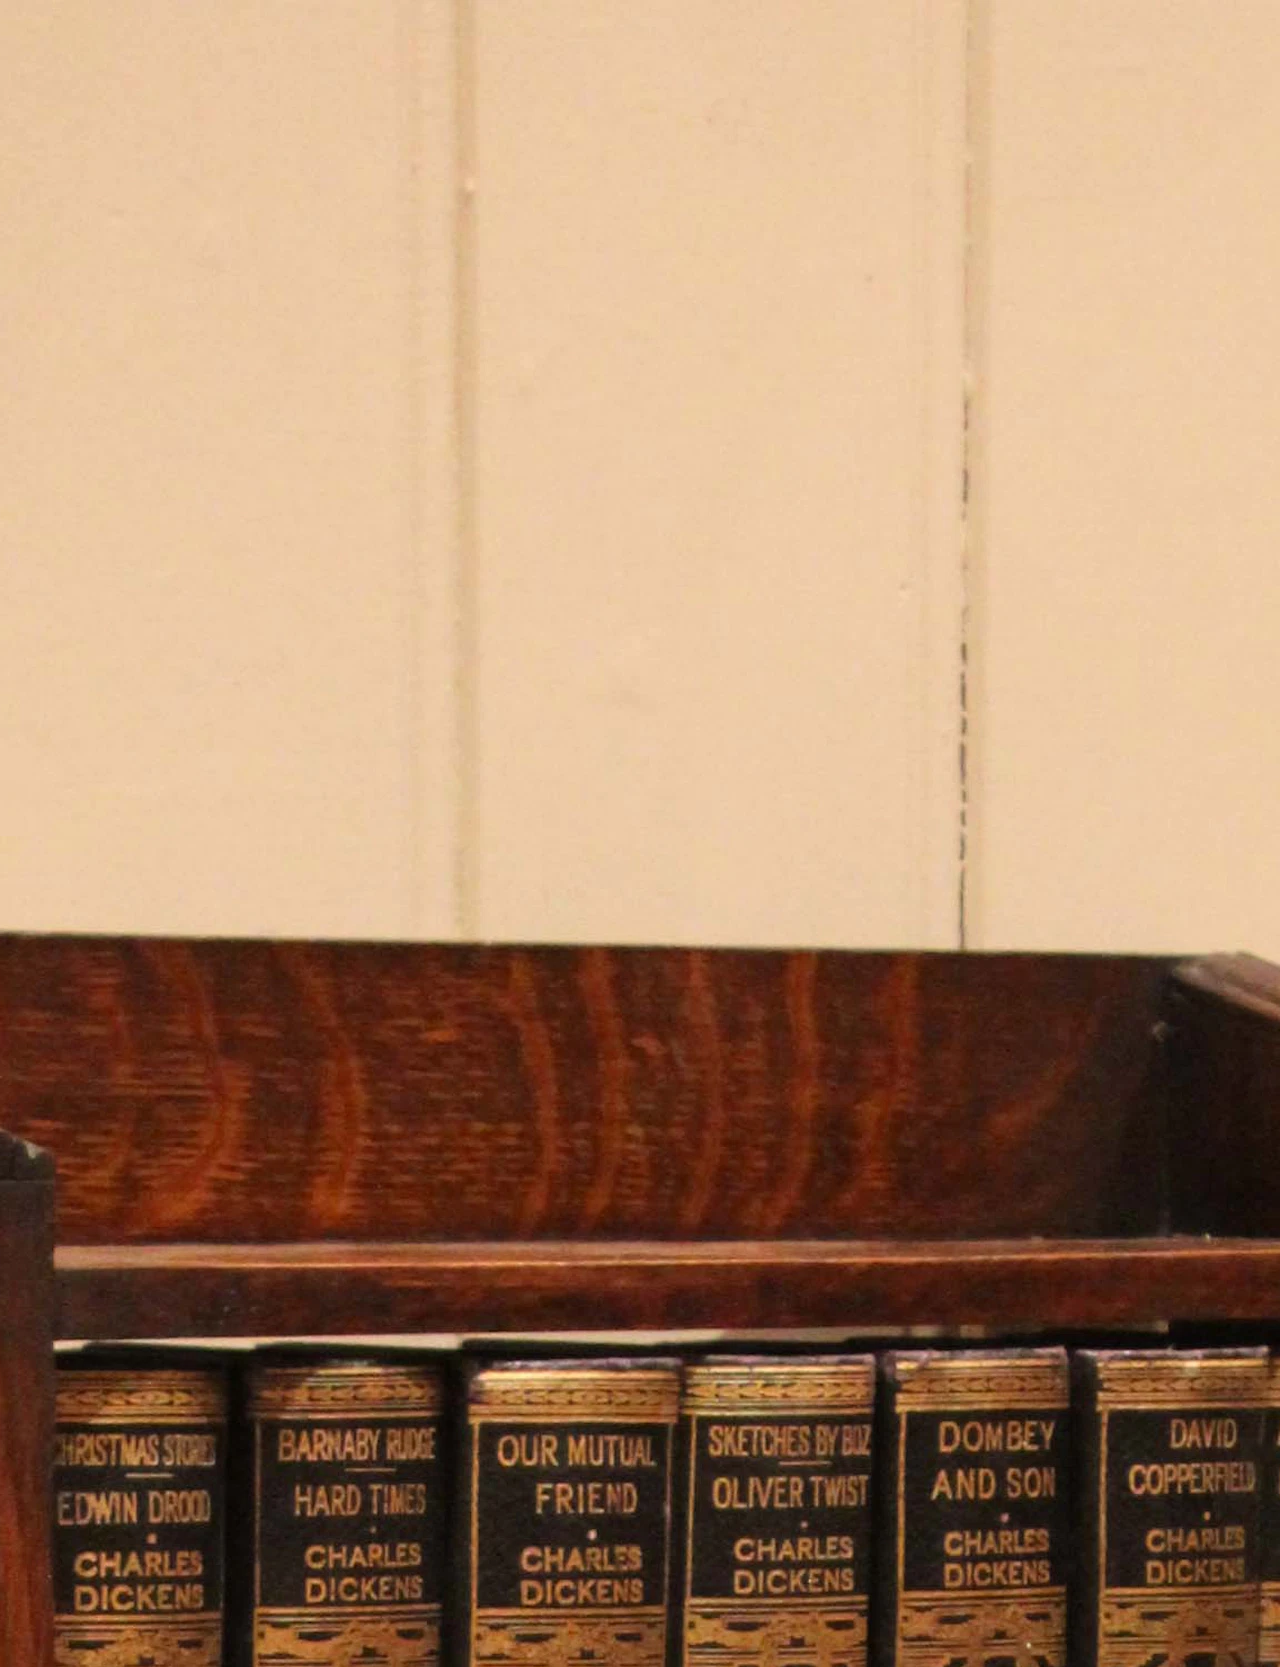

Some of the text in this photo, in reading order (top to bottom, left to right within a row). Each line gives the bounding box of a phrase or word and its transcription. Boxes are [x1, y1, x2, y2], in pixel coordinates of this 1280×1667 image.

[277, 1427, 438, 1463] BARNABY RUDGE
[708, 1424, 872, 1458] SKETCHES BY BOZ
[939, 1420, 1056, 1453] DOMBEY
[1169, 1418, 1238, 1449] DAVID
[496, 1434, 657, 1467] OUR MUTUAL
[711, 1474, 870, 1510] OLIVER TWIST
[931, 1467, 1056, 1500] AND SON
[1128, 1461, 1257, 1496] COPPERFIELD
[57, 1489, 212, 1526] EDWIN DROOD
[293, 1483, 427, 1518] HARD TIMES
[535, 1482, 638, 1515] FRIEND
[733, 1535, 854, 1563] CHARLES
[943, 1527, 1050, 1557] CHARLES
[1145, 1525, 1246, 1553] CHARLES
[73, 1550, 204, 1579] CHARLES
[304, 1542, 422, 1570] CHARLES
[520, 1544, 643, 1574] CHARLES
[733, 1567, 855, 1596] DICKENS
[943, 1559, 1051, 1588] DICKENS
[1145, 1557, 1246, 1586] DICKENS
[73, 1583, 205, 1613] DICKENS
[304, 1575, 424, 1604] DICKENS
[520, 1578, 644, 1607] DICKENS
